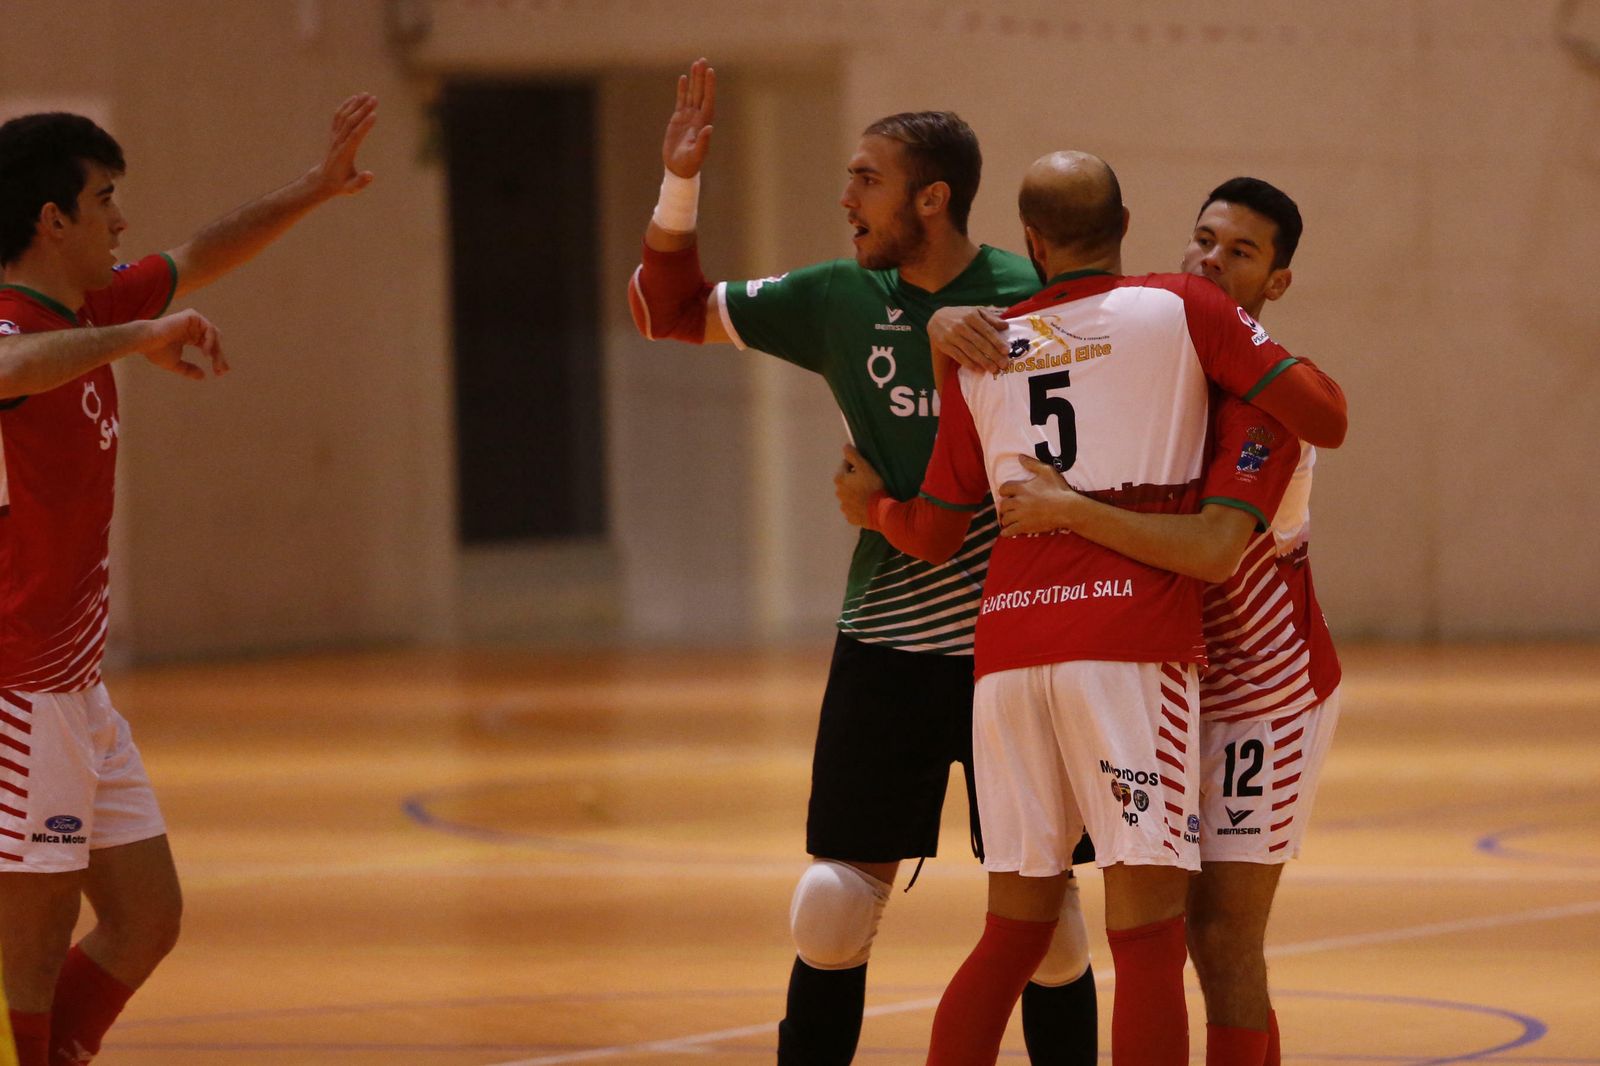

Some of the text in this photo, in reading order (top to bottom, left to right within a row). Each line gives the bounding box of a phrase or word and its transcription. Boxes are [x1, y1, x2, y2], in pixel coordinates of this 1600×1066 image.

[1076, 343, 1112, 362] Elite
[1028, 370, 1077, 473] 5
[1092, 579, 1133, 598] SALA
[1223, 739, 1264, 797] 12
[53, 819, 77, 830] Ford
[1217, 827, 1261, 835] BEMISER
[31, 833, 87, 844] Mica Motor
